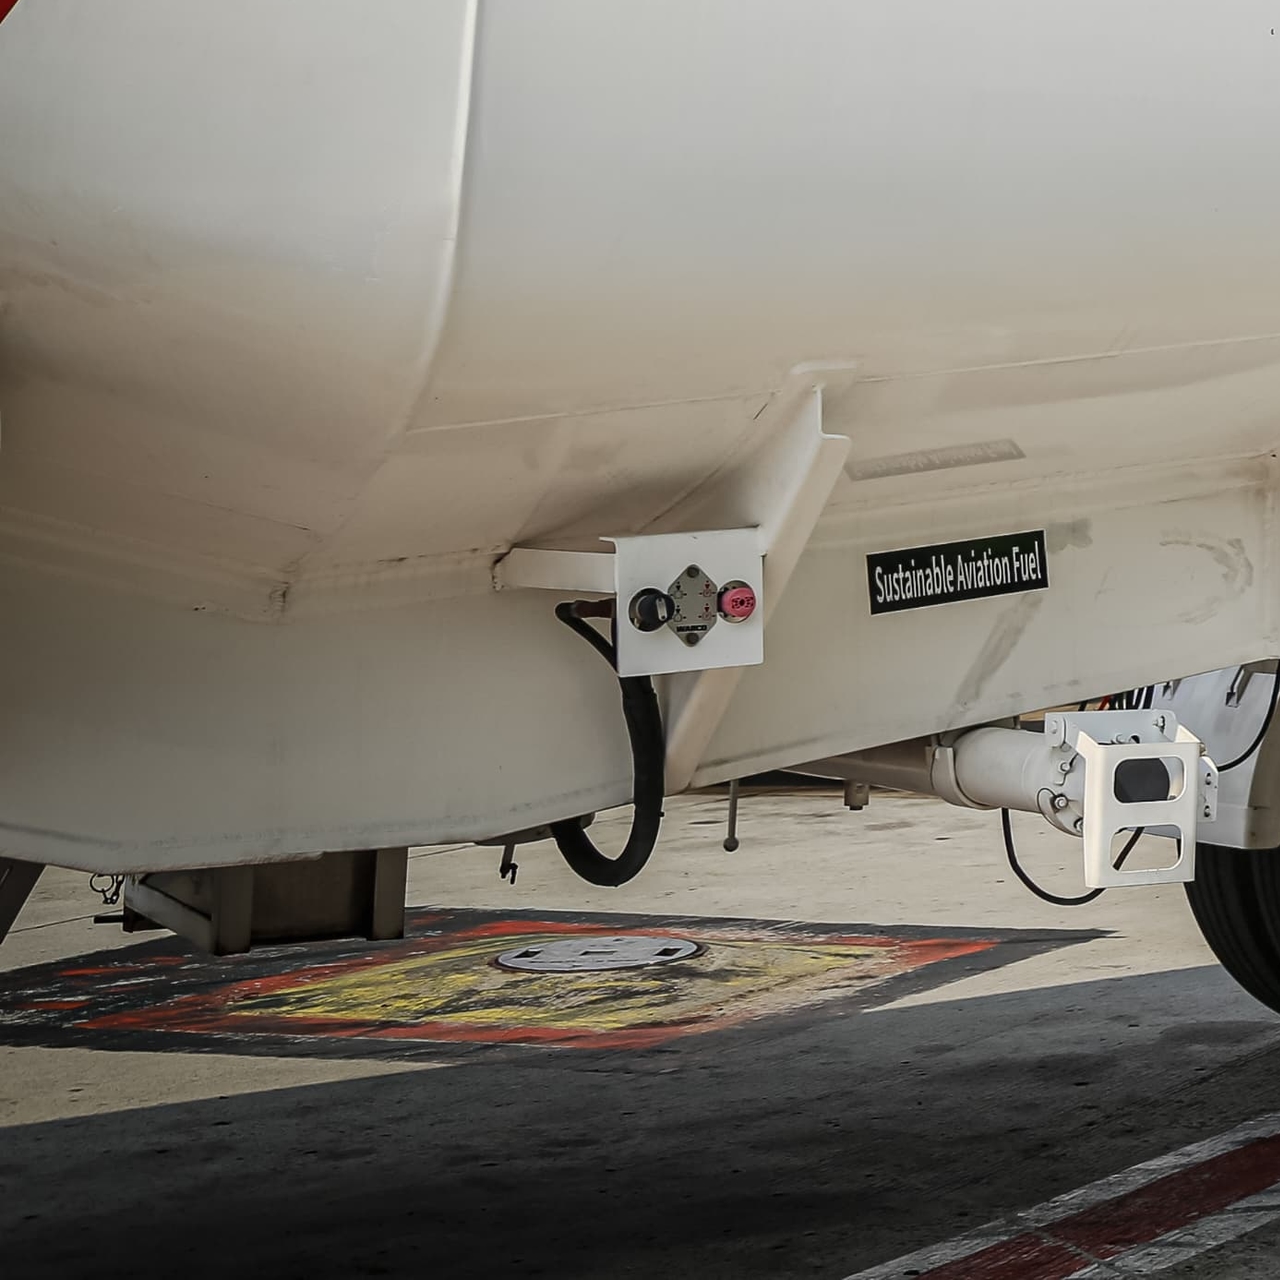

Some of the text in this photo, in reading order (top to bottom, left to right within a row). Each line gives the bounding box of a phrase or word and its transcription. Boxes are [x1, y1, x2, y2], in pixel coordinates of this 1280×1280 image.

[875, 540, 1042, 603] Sustainable Aviation Fuel
